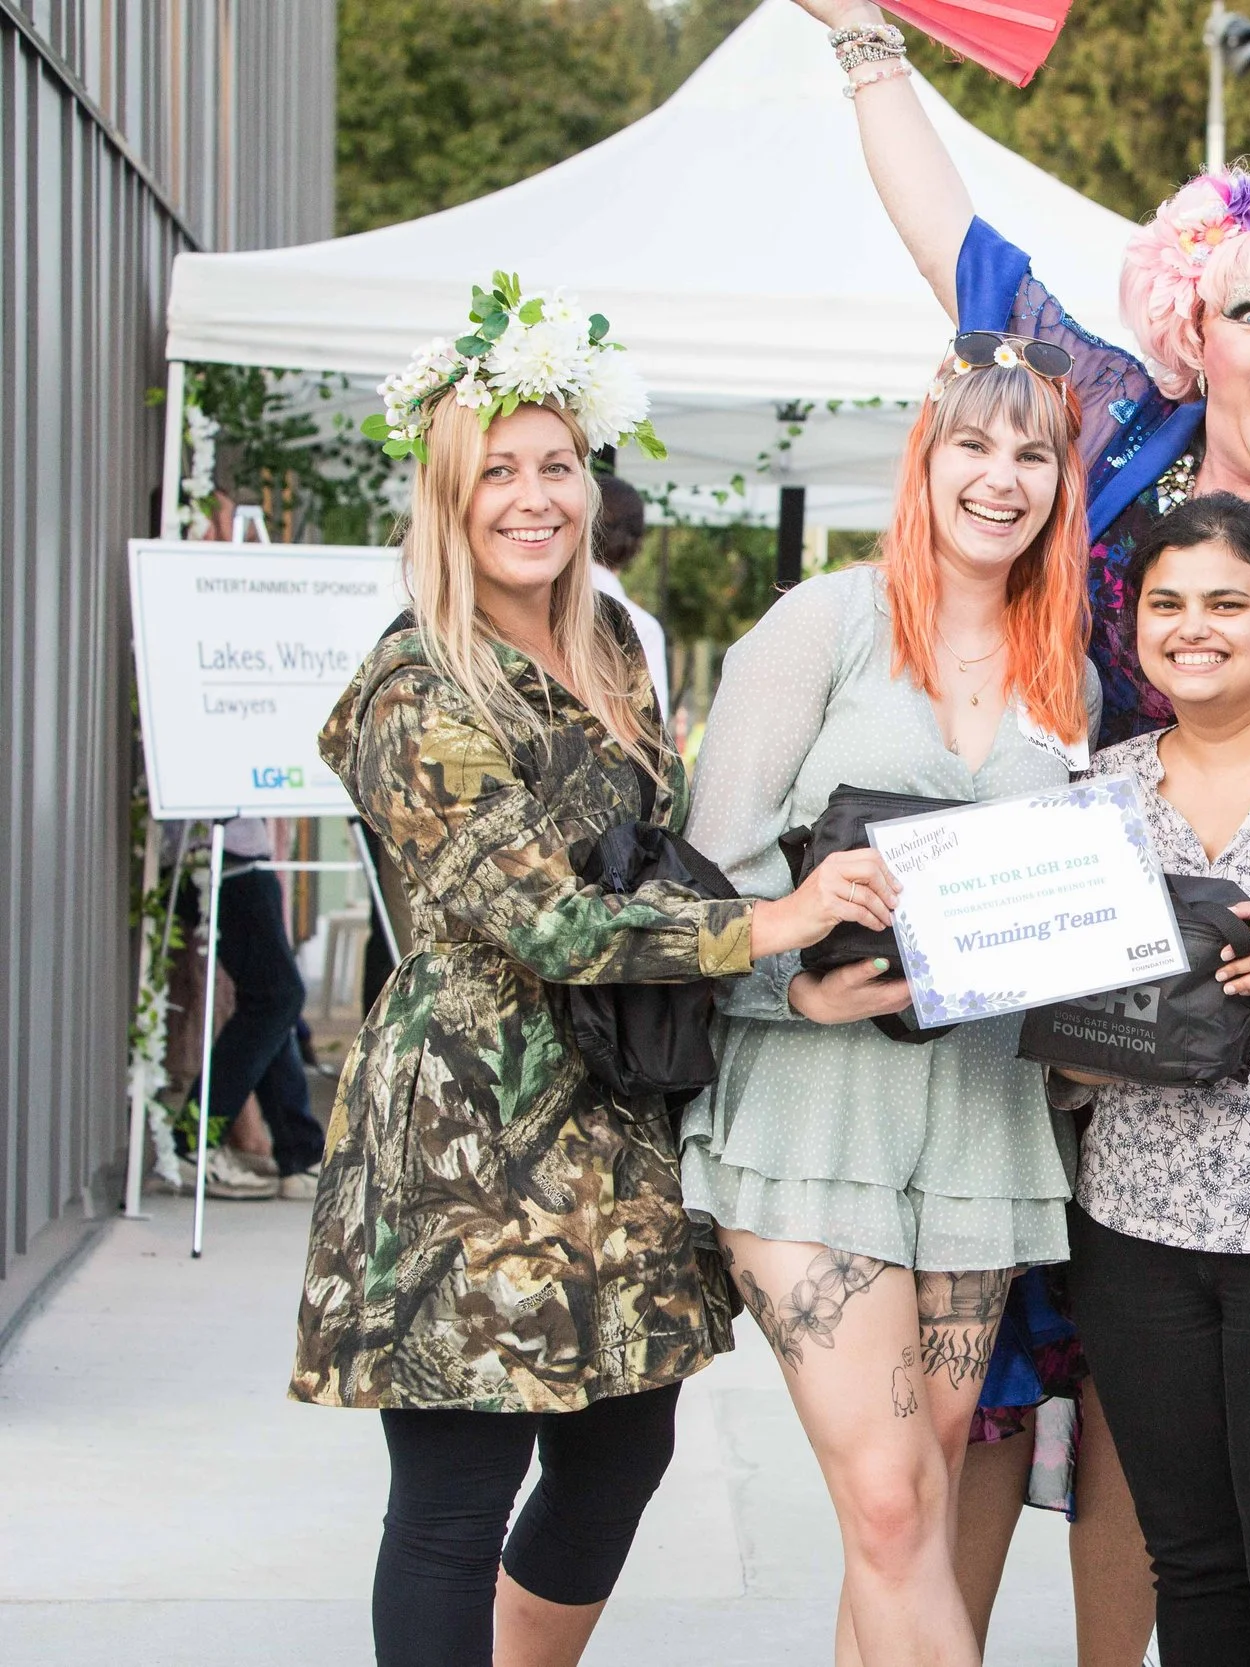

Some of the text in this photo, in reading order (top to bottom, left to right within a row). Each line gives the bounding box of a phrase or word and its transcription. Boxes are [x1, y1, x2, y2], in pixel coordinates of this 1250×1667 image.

[196, 577, 378, 596] ENTERTAINMENT SPONSOR
[197, 641, 273, 673] Lakes,
[277, 642, 349, 677] Whyte
[202, 692, 277, 719] Lawyers
[939, 853, 1100, 897] BOWL FOR LGH 2023
[943, 876, 1107, 918] CONGRATULATIONS FOR BEING THE
[953, 907, 1118, 954] Winning Team
[1127, 943, 1157, 961] LGH
[1131, 957, 1175, 972] FOUNDATION
[1053, 1021, 1156, 1055] FOUNDATION
[1054, 1011, 1156, 1040] LIONS GATE HOSPITAL
